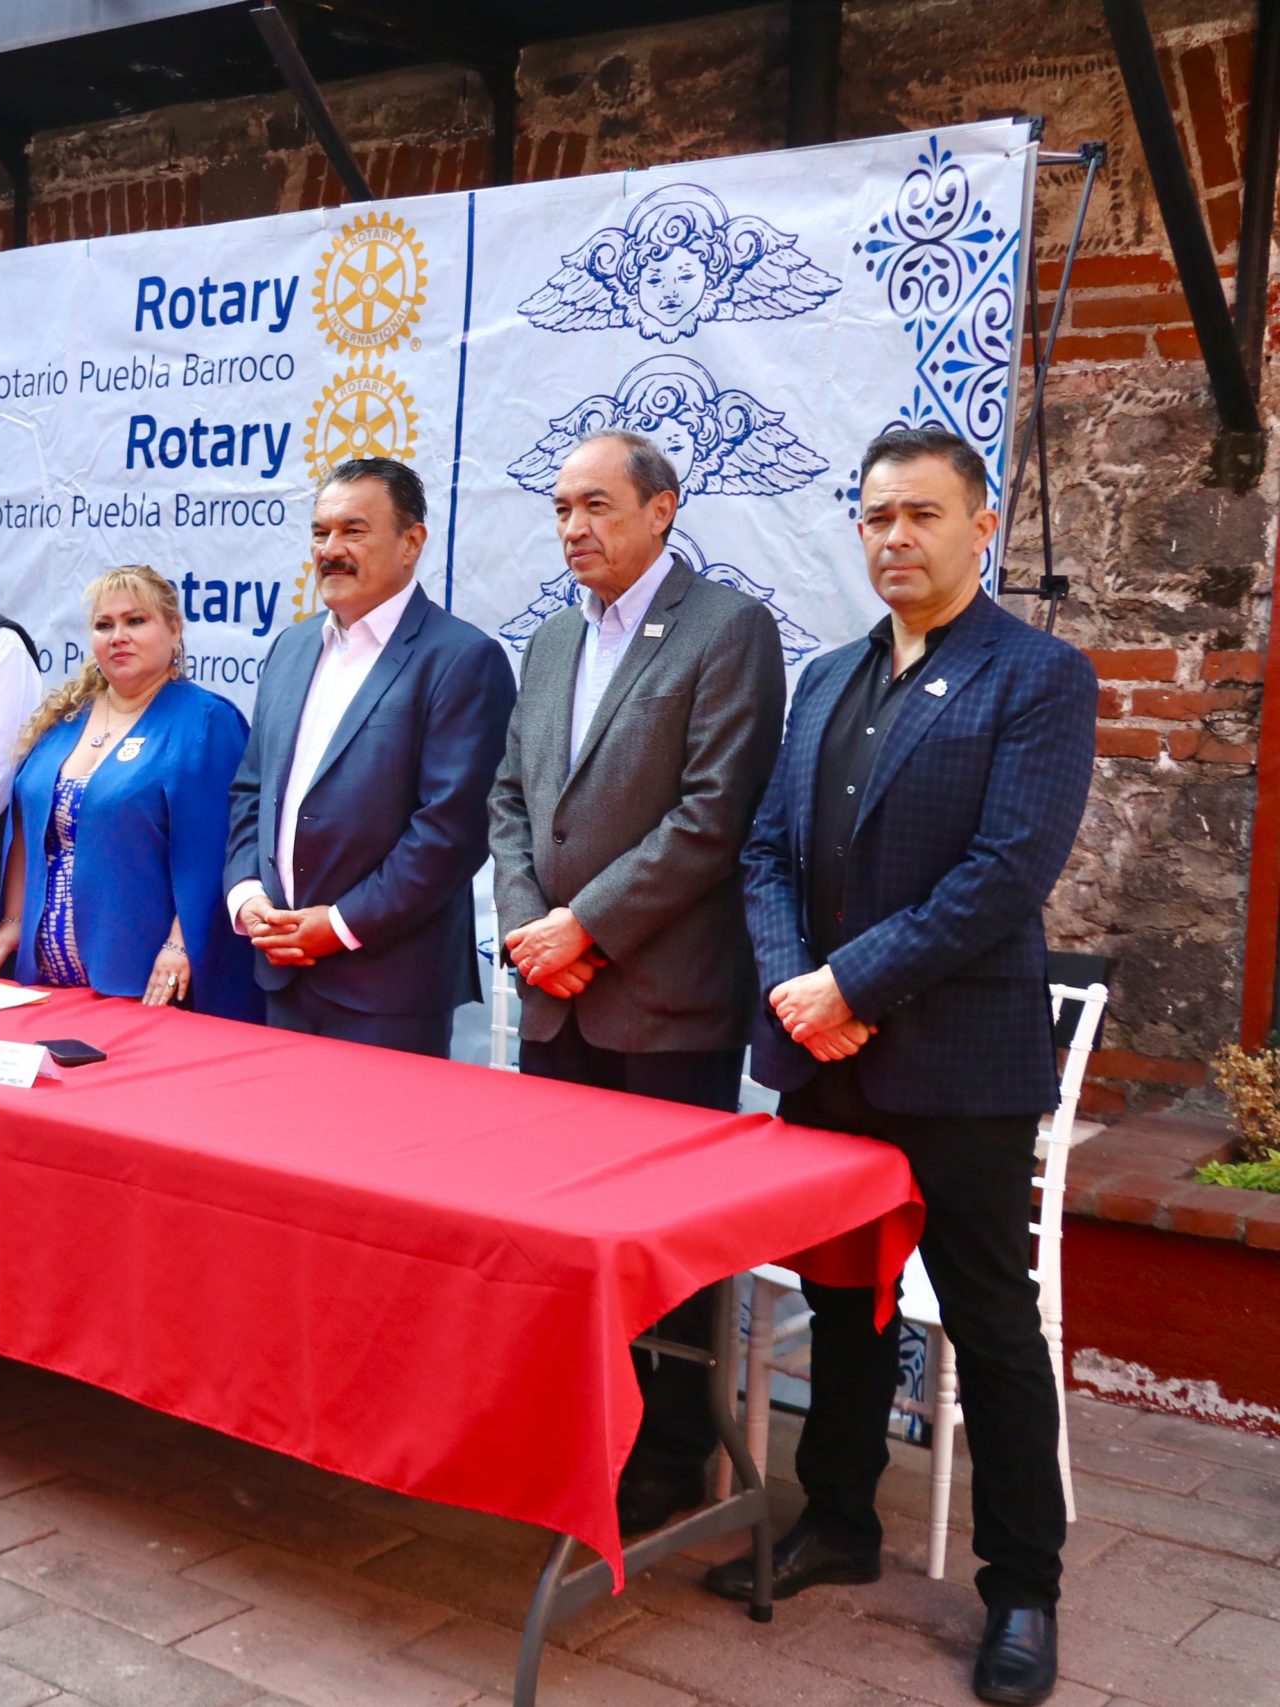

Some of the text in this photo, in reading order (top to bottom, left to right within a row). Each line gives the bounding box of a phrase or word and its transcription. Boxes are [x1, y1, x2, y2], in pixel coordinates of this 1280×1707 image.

[349, 229, 398, 248] ROTARY
[135, 275, 299, 333] Rotary
[329, 307, 410, 347] INTERNATIONAL
[79, 353, 171, 394] Puebla
[181, 351, 295, 387] Barroco
[339, 379, 387, 398] ROTARY
[125, 413, 292, 480] Rotary
[71, 491, 160, 528] Puebla
[174, 491, 285, 527] Barroco
[170, 571, 281, 637] tary
[186, 655, 265, 685] arroc
